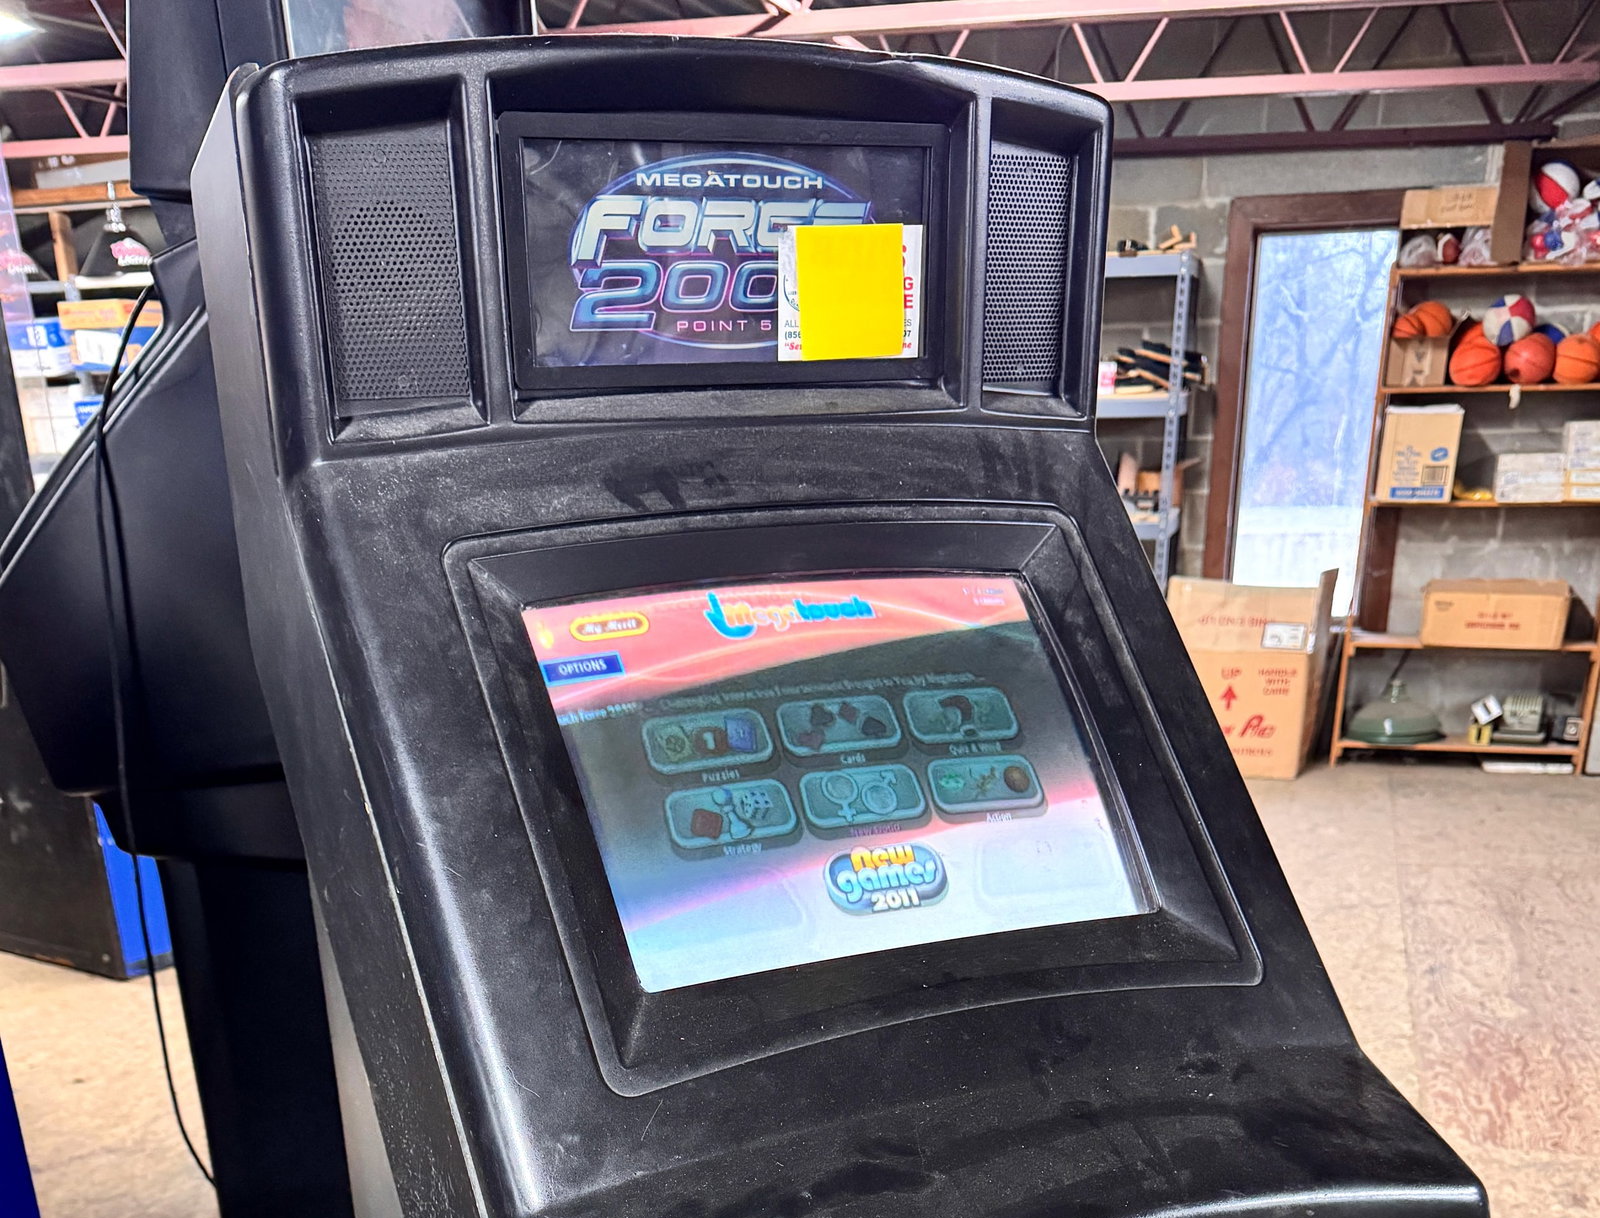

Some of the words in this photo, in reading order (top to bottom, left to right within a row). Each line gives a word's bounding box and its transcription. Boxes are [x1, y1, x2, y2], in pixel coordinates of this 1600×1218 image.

[636, 171, 823, 190] MEGATOUCH
[570, 259, 779, 332] 200
[676, 319, 748, 332] POINT
[760, 320, 772, 331] 5
[558, 659, 608, 675] OPTIONS
[836, 860, 938, 903] games
[871, 887, 922, 913] 2011
